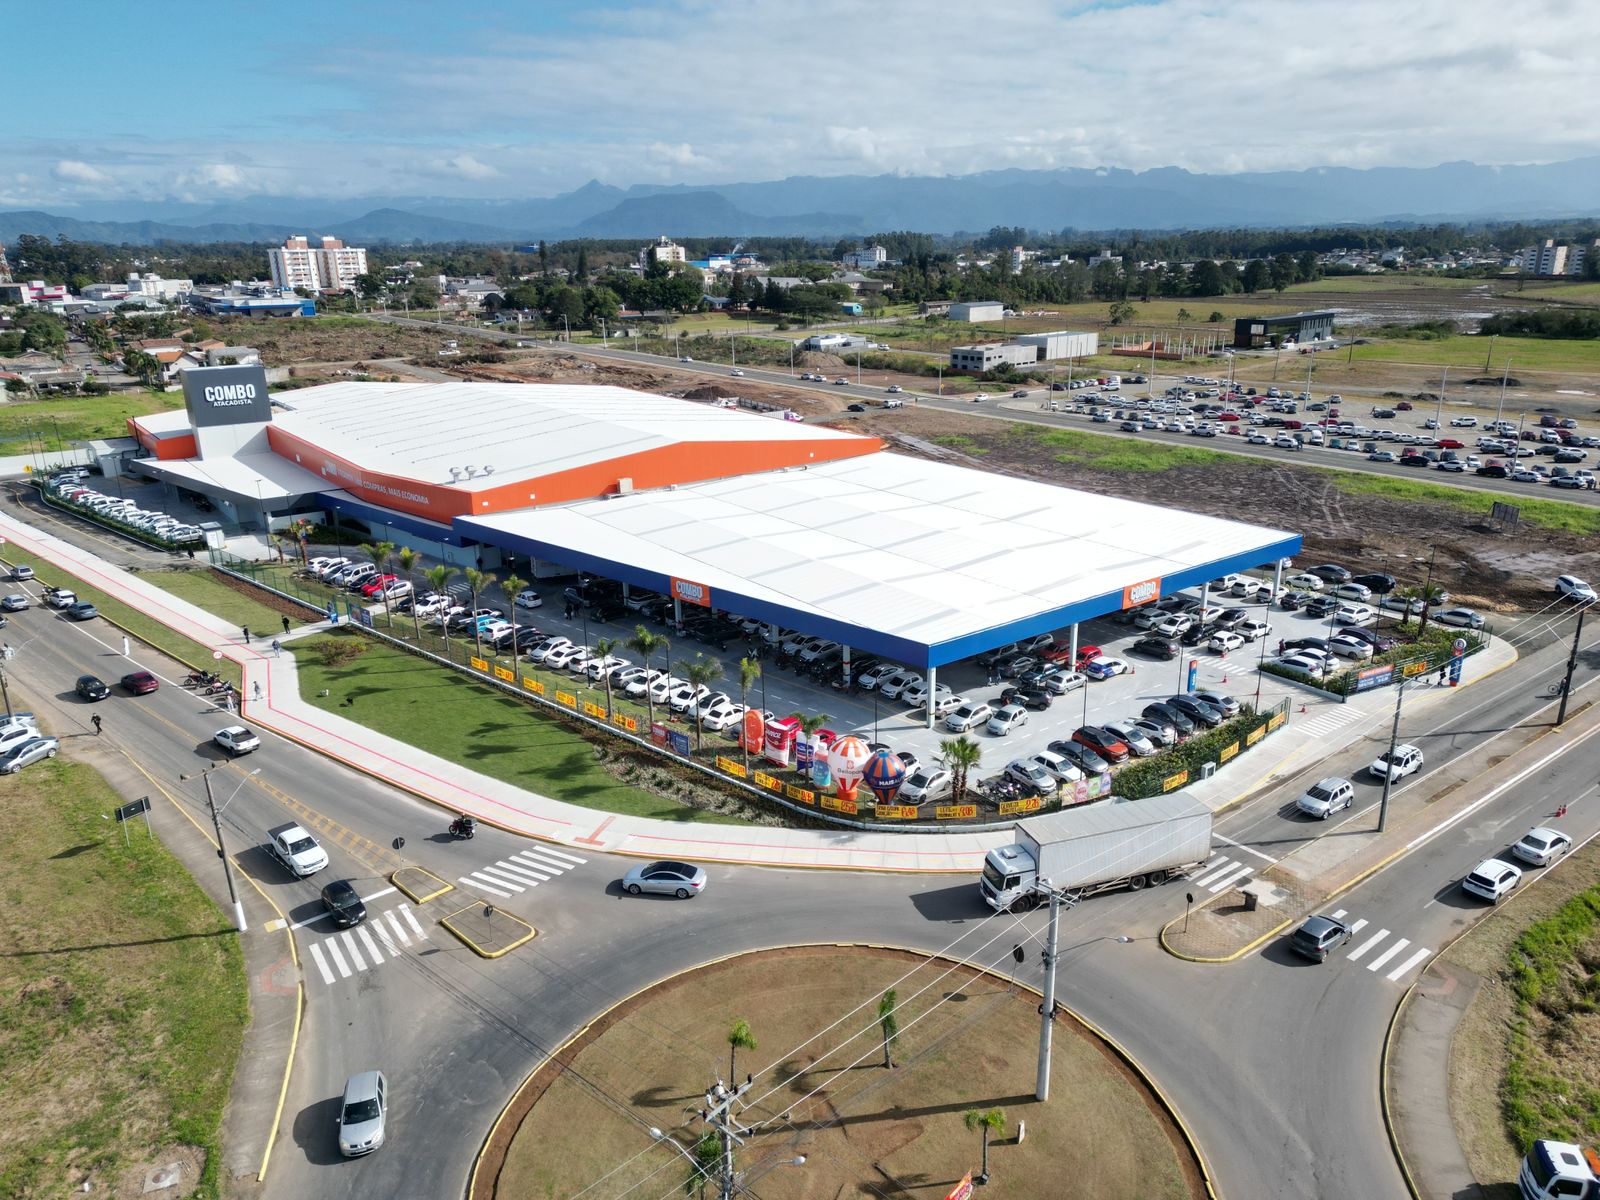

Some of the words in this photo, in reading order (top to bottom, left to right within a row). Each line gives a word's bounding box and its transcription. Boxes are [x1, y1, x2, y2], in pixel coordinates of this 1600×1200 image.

[204, 383, 256, 402] COMBO
[213, 399, 252, 407] ATACADISTA
[388, 487, 401, 497] MAIS
[401, 490, 429, 504] ECONOMIA
